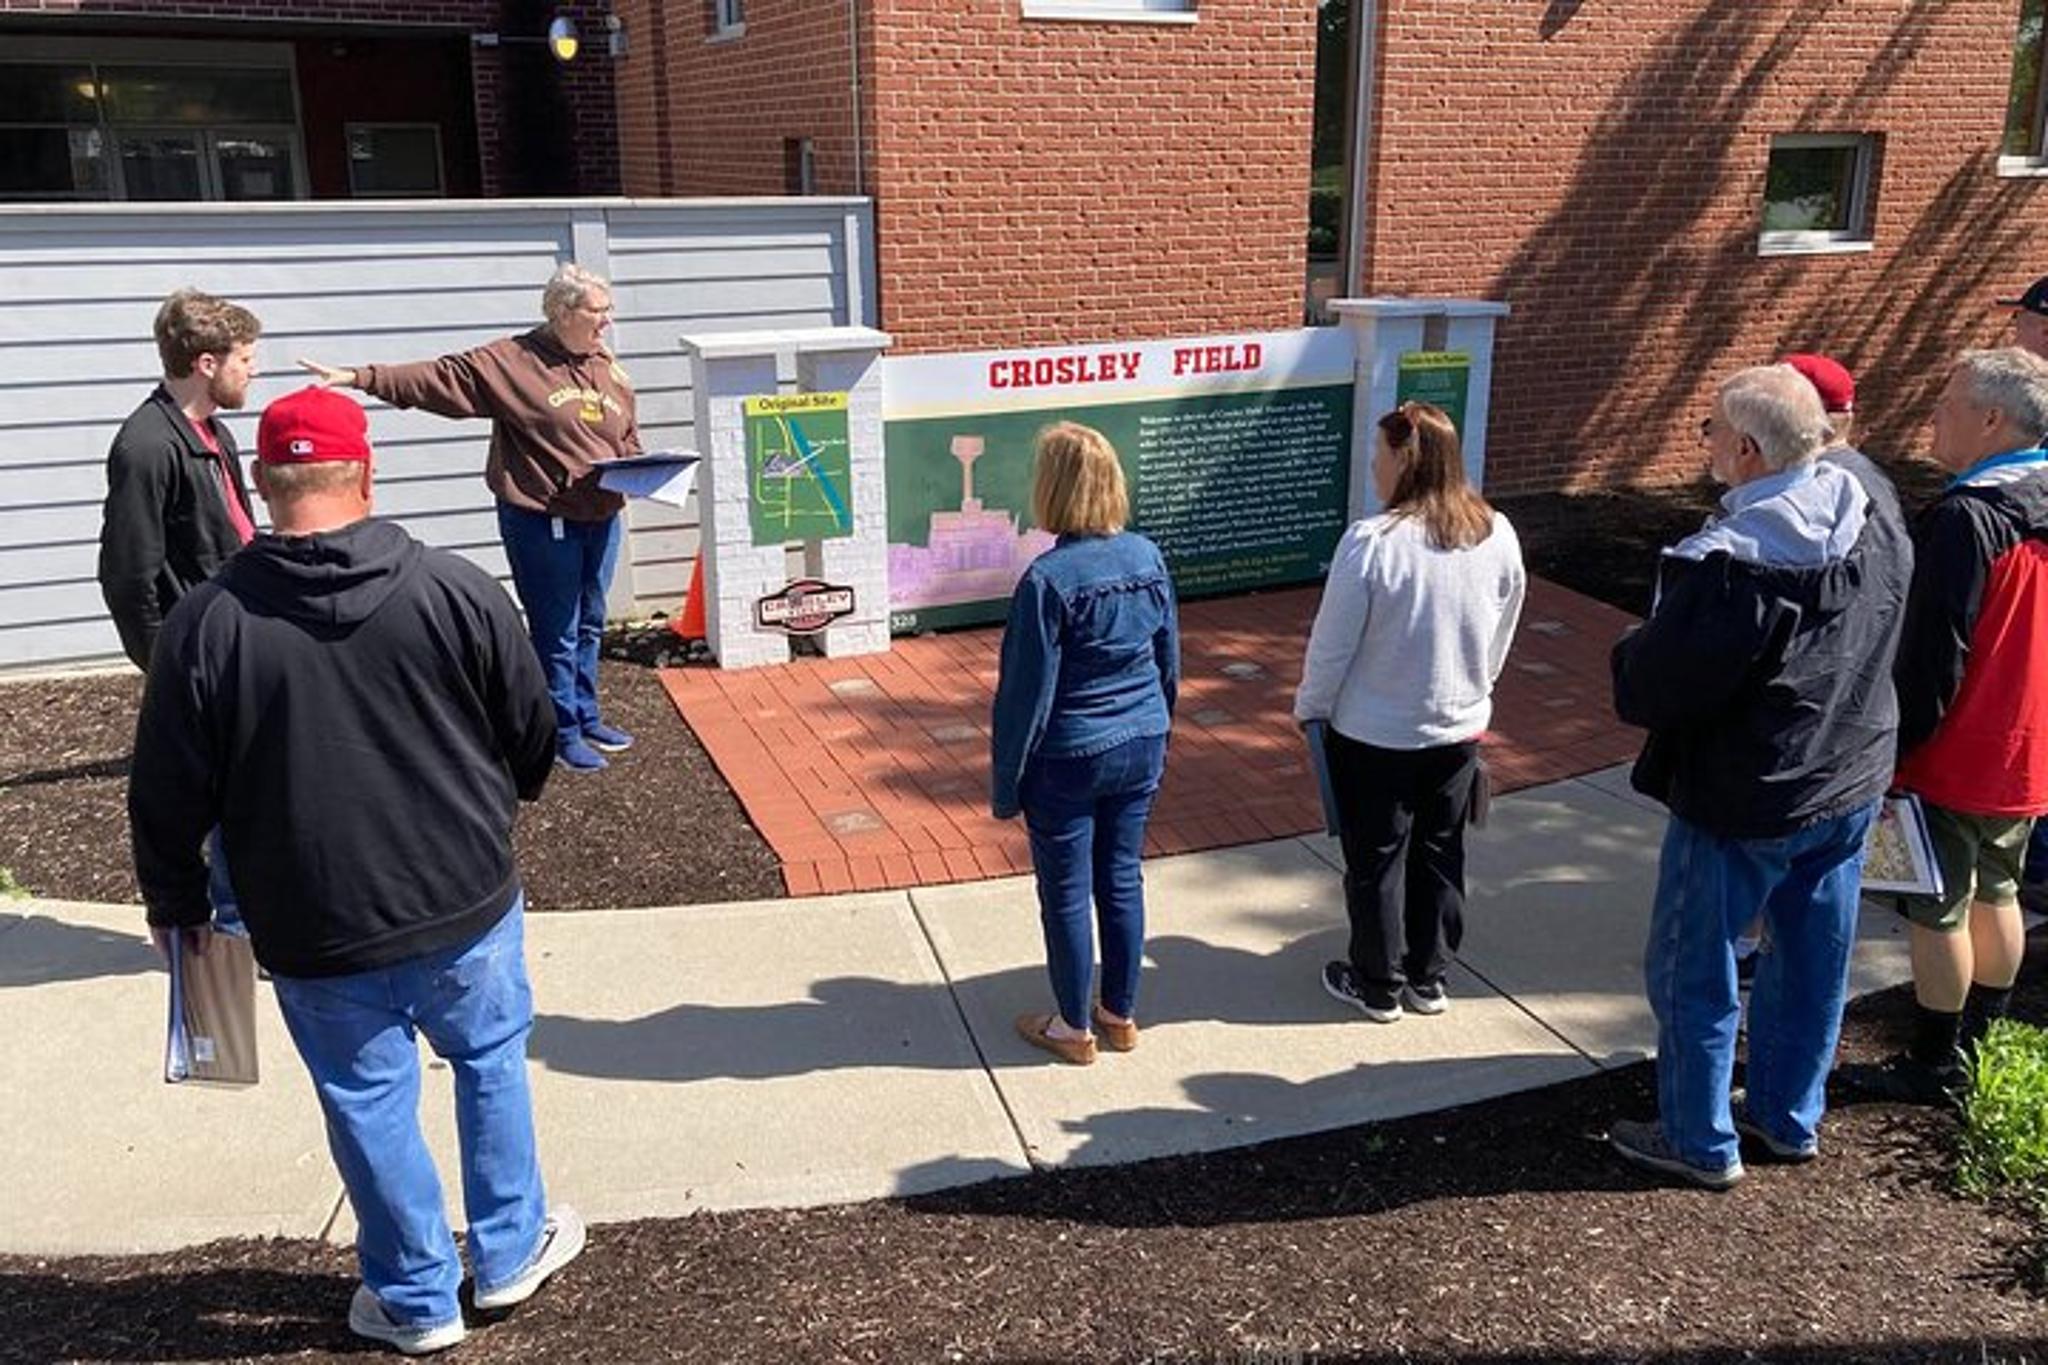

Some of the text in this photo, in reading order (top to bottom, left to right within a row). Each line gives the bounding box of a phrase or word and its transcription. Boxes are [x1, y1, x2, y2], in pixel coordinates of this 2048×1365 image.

[988, 343, 1262, 388] CROSLEY FIELD
[759, 393, 838, 410] Original Site
